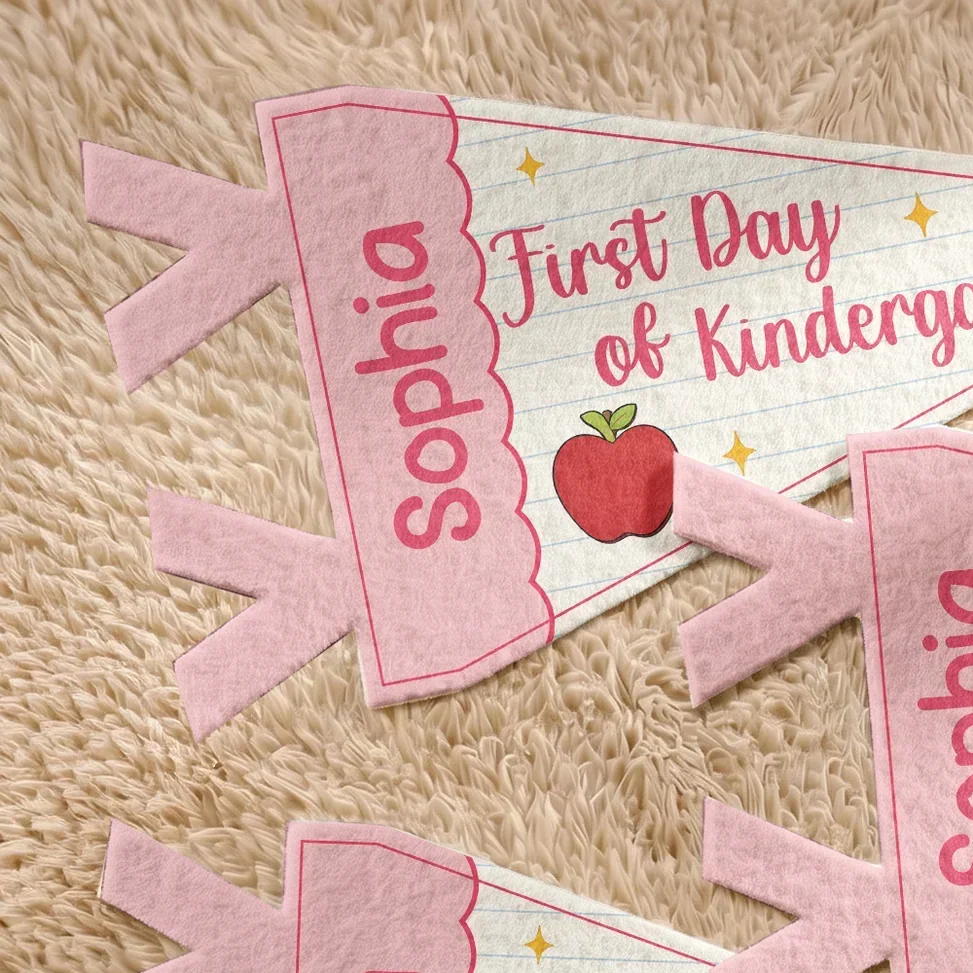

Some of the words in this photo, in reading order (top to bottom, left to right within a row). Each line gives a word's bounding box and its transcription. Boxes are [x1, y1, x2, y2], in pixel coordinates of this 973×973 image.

[490, 208, 668, 328] First
[691, 190, 841, 284] Day
[352, 220, 485, 550] Sophia
[595, 302, 671, 386] of
